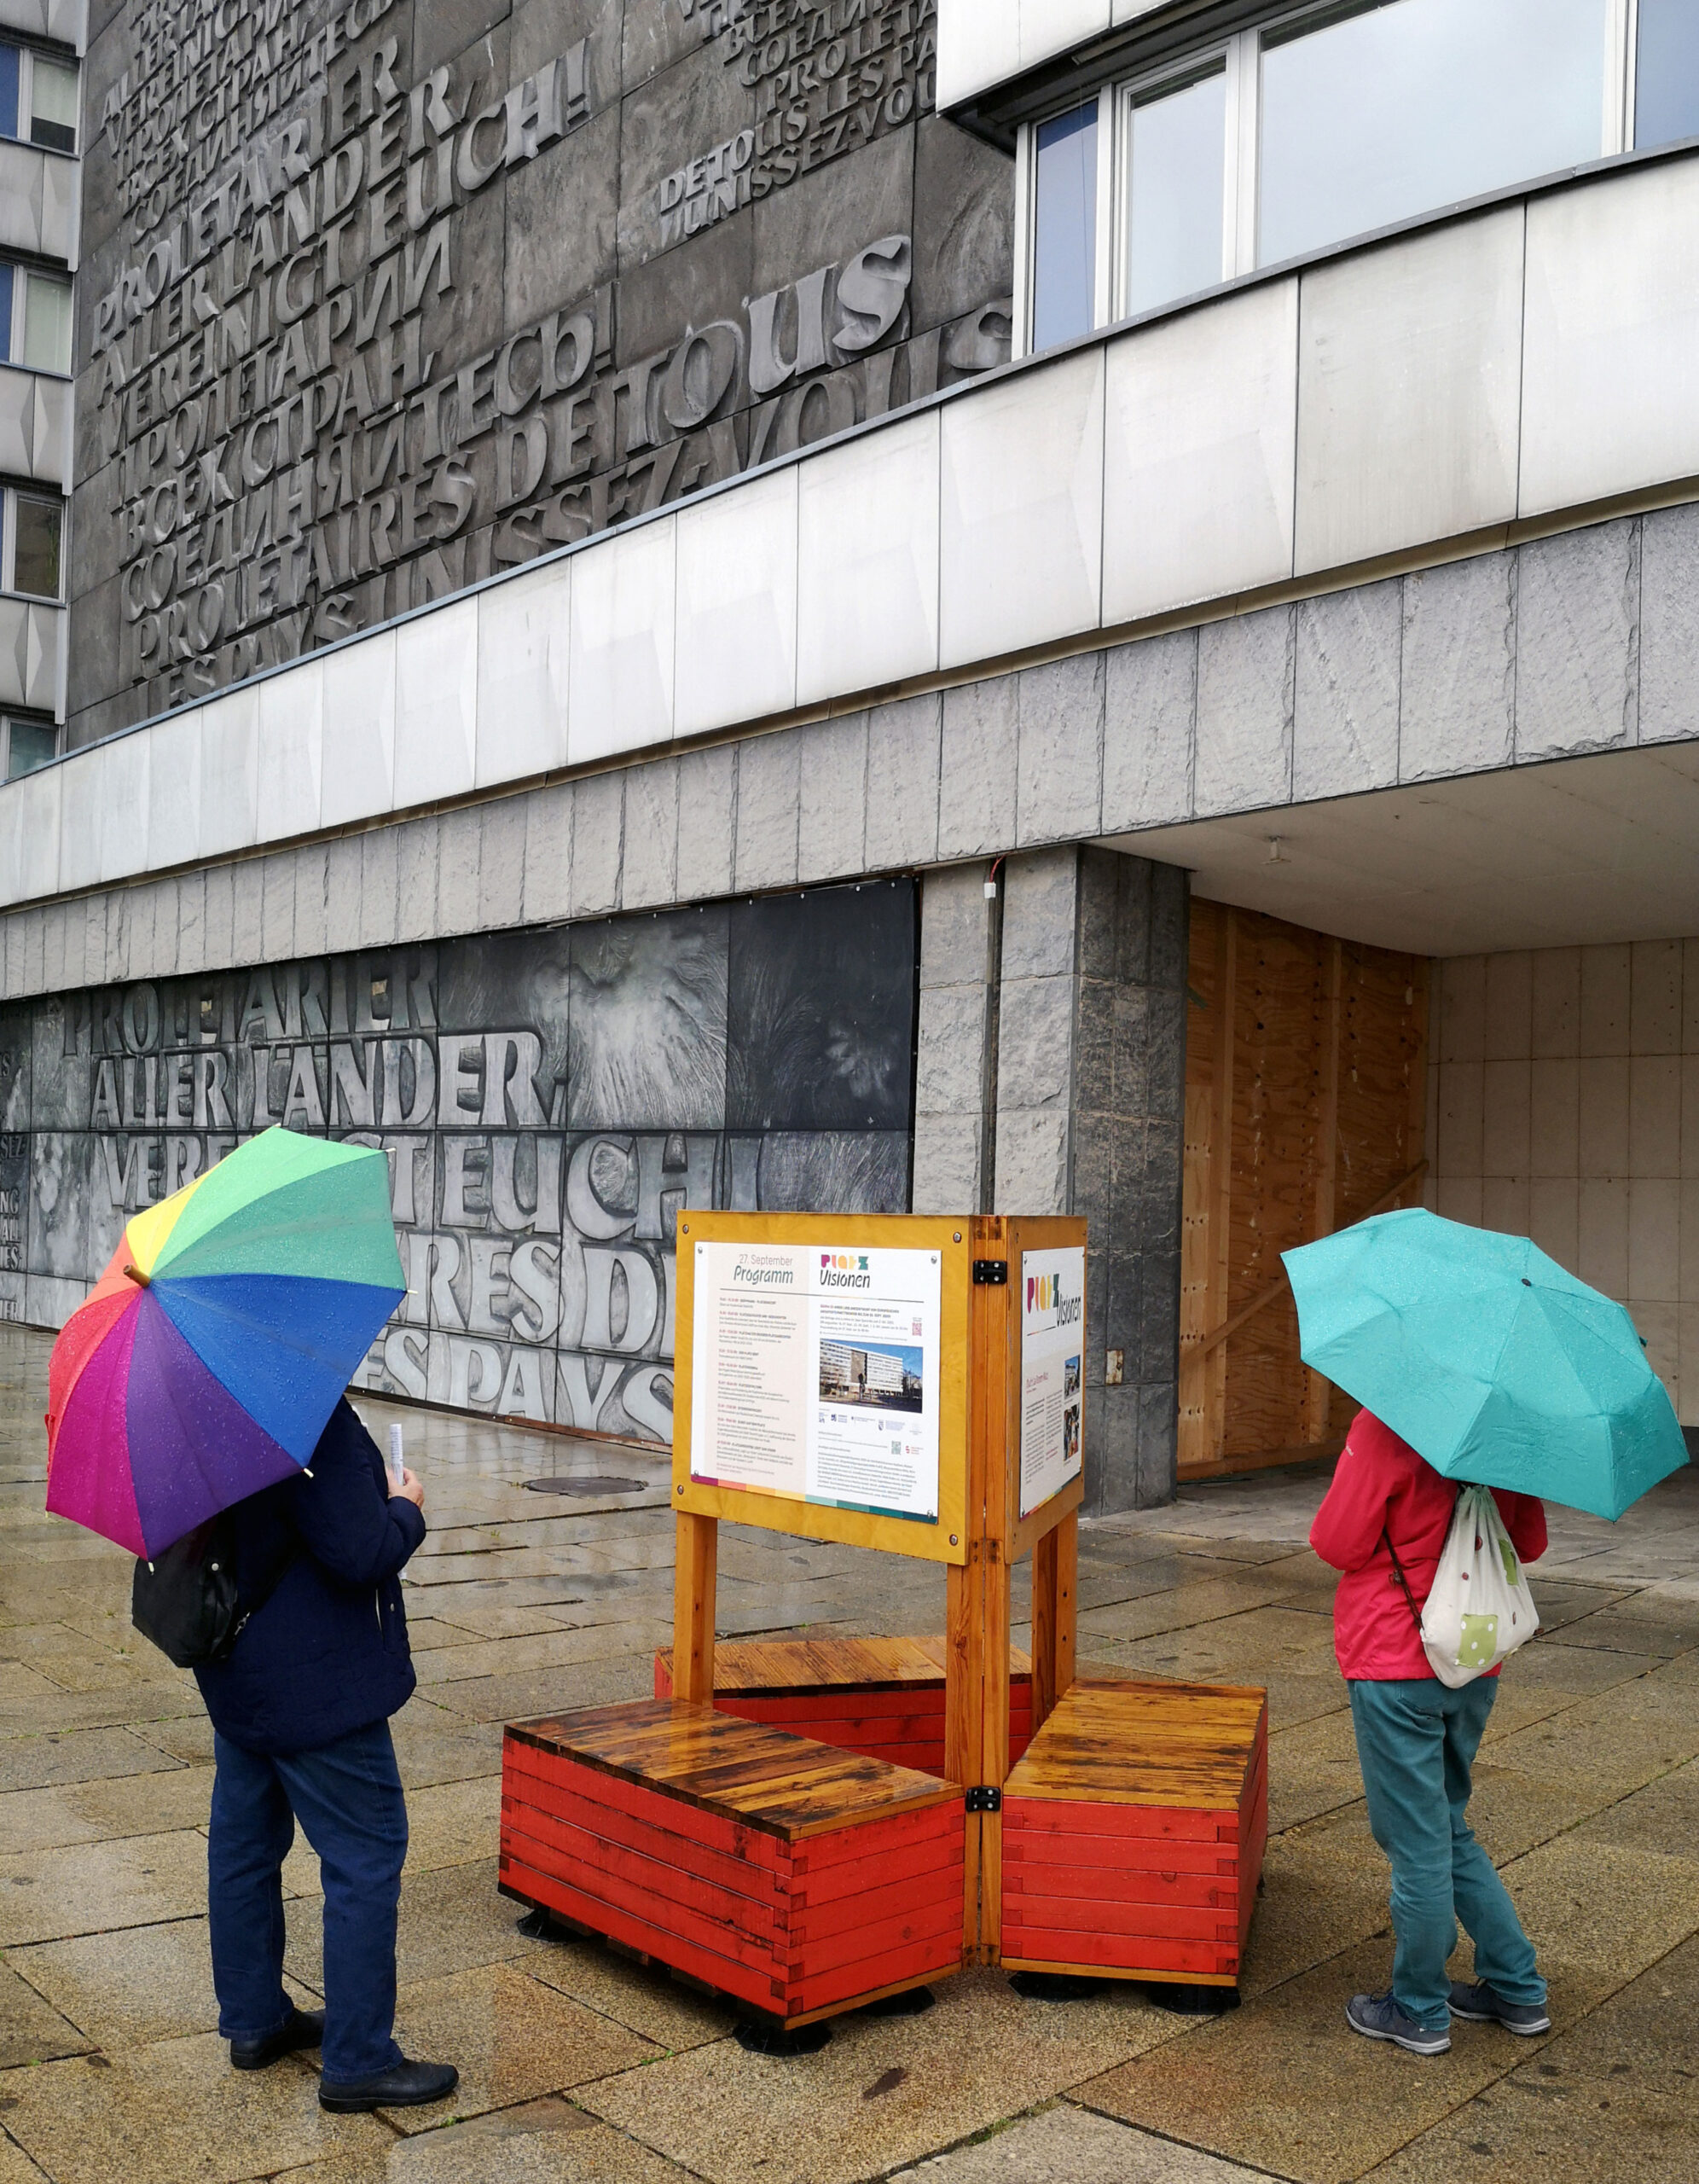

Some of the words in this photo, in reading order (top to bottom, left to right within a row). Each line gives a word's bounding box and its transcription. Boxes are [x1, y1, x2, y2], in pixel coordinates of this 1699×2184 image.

[92, 34, 405, 356] PROLETARIER
[660, 155, 706, 214] DE
[707, 99, 810, 185] TOUS
[820, 58, 884, 123] LES
[100, 209, 357, 456] VEREINIGT
[369, 36, 592, 266] EUCH!
[98, 265, 221, 410] ALLER
[495, 384, 599, 514] DE
[612, 235, 912, 456] TOUS
[90, 1048, 235, 1127] ALLER
[734, 1265, 793, 1285] Programm
[751, 1254, 793, 1266] September
[820, 1269, 870, 1289] Visionen
